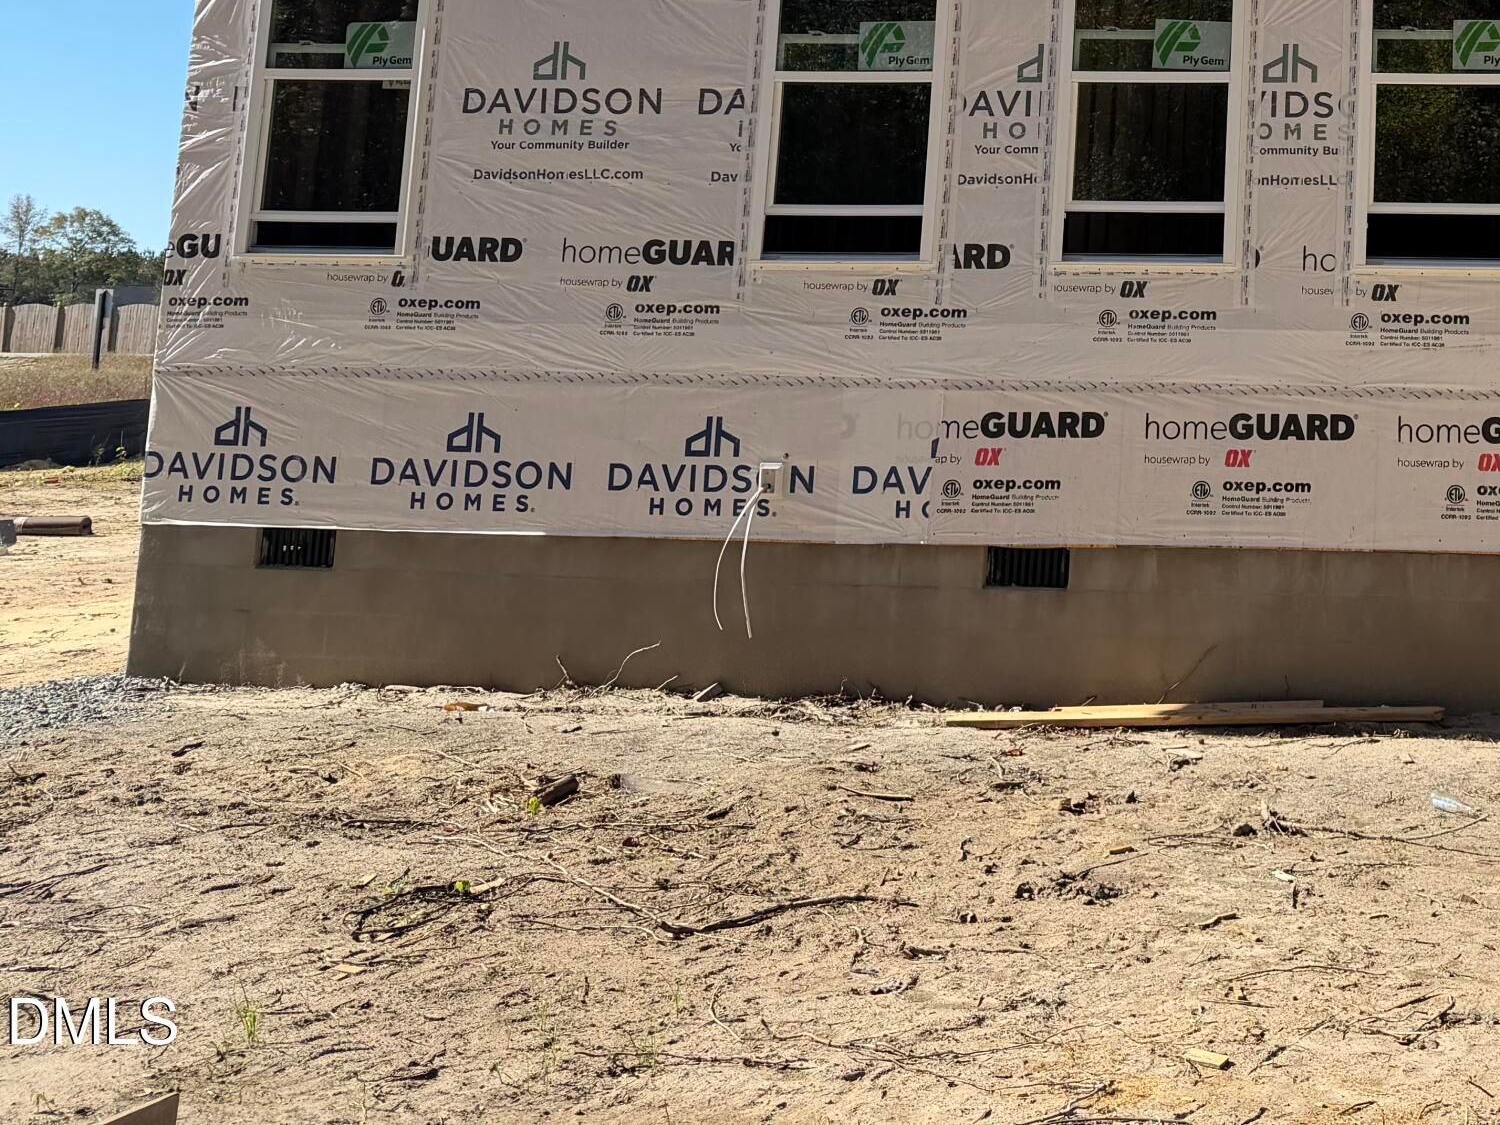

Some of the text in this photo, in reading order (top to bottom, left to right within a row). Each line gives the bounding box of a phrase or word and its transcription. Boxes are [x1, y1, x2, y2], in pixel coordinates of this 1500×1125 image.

[1183, 55, 1224, 67] Ply Gem
[1484, 55, 1500, 67] Ply
[462, 88, 662, 114] DAVIDSON
[499, 119, 617, 136] HOMES
[491, 140, 630, 151] Your Community Builder
[975, 145, 1000, 155] Your
[1259, 146, 1318, 156] ommunity
[473, 169, 643, 180] DavidsonHomesLLC.com
[562, 238, 734, 266] homeGUAR
[327, 272, 388, 283] housewrap by
[560, 275, 655, 292] housewrap by OX
[803, 279, 900, 295] housewrap by OX
[1105, 283, 1116, 294] by
[1120, 281, 1149, 298] OX
[1356, 284, 1400, 301] by OX
[169, 296, 248, 308] oxep.com
[398, 298, 480, 310] oxep.com
[635, 303, 720, 316] oxep.com
[880, 307, 967, 320] oxep.com
[1129, 309, 1217, 322] oxep.com
[1380, 312, 1470, 325] oxep.com
[1145, 412, 1355, 441] homeGUARD
[950, 454, 962, 464] by
[975, 448, 1003, 466] OX
[1144, 449, 1253, 467] housewrap by OX
[1397, 458, 1450, 468] housewrap
[1452, 458, 1464, 470] by
[370, 457, 572, 490] DAVIDSON
[608, 463, 815, 493] DAVIDSN
[973, 479, 1061, 492] oxep.com
[1223, 480, 1311, 494] oxep.com
[178, 485, 294, 505] HOMES
[410, 492, 529, 512] HOMES
[649, 498, 770, 517] HOMES
